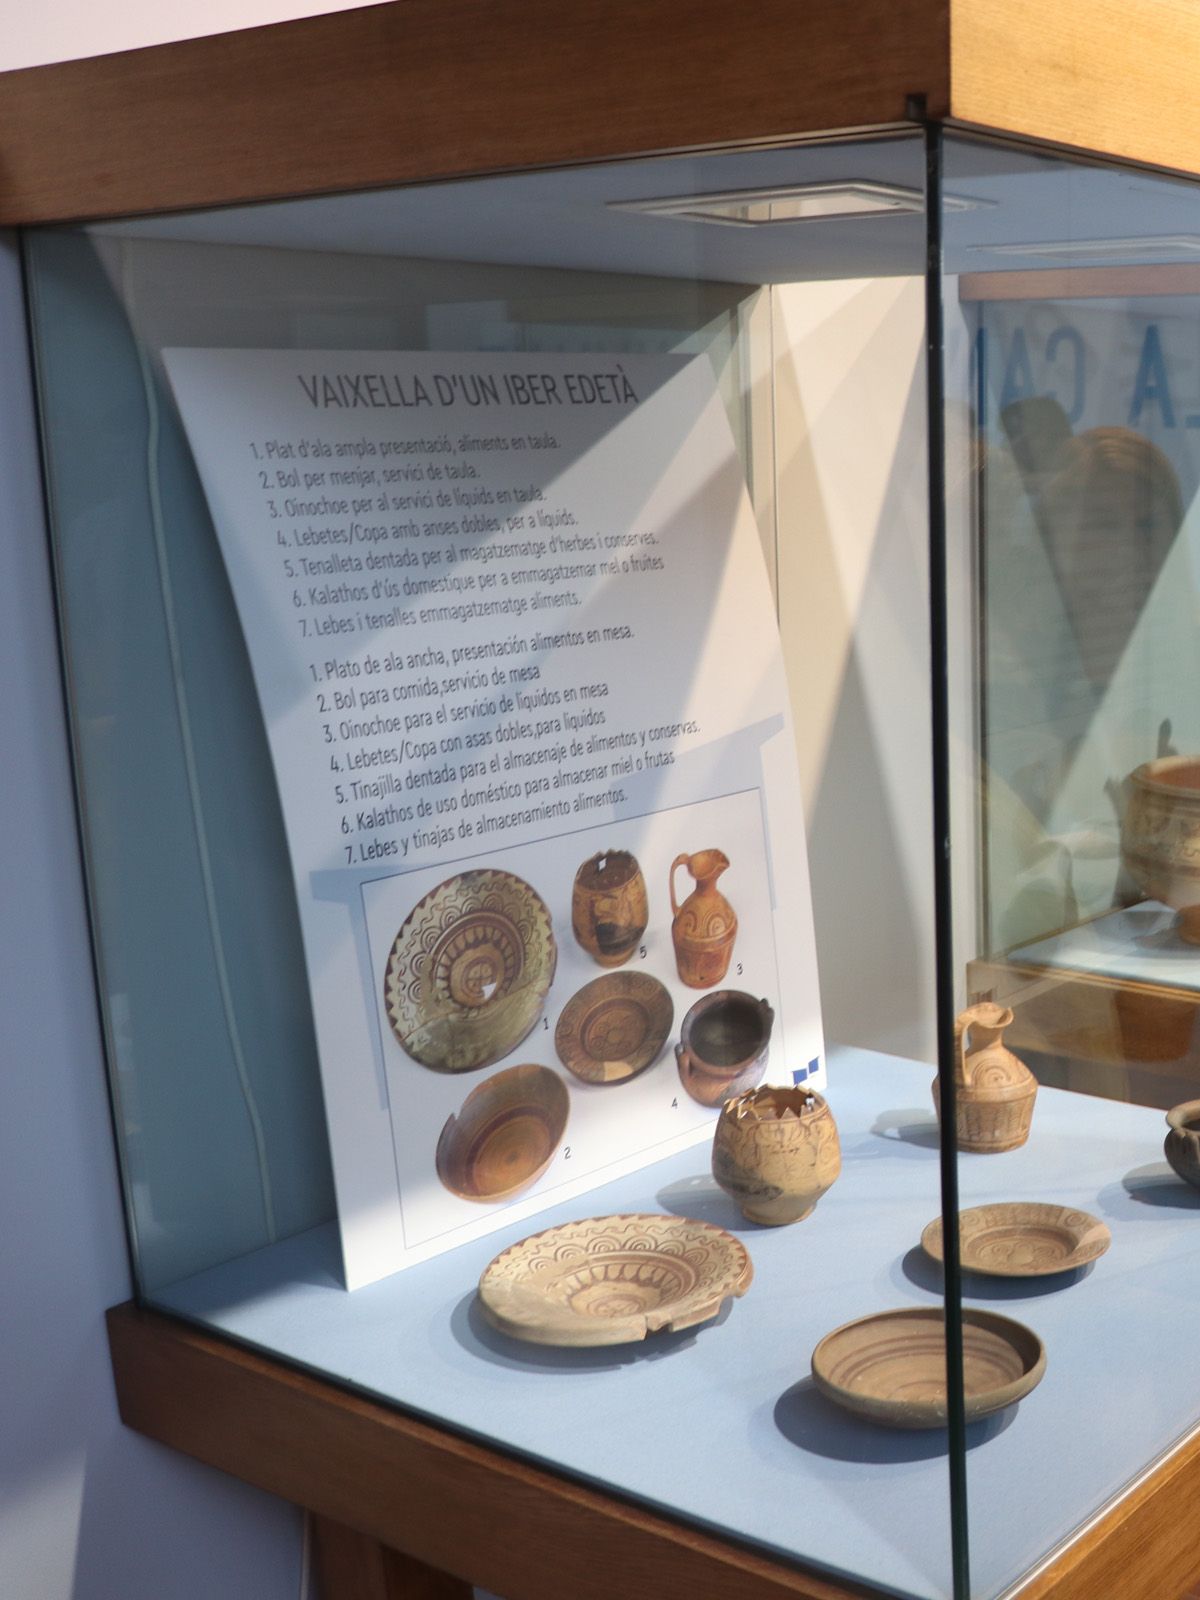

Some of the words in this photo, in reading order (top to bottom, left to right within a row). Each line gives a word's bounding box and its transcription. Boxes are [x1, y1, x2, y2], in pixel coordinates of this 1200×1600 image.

[298, 374, 432, 408] VAIXELLA
[433, 373, 501, 407] D'UN
[503, 373, 562, 406] IBER
[564, 363, 640, 404] EDETÀ
[250, 442, 264, 460] 1.
[266, 440, 296, 459] Plat
[298, 438, 332, 458] d'ala
[336, 438, 376, 459] ampla
[379, 434, 456, 458] presentació,
[458, 434, 509, 453] aliments
[511, 437, 524, 450] en
[528, 433, 561, 450] taula.
[259, 471, 274, 489] 2.
[277, 469, 299, 488] Bol
[304, 471, 325, 490] per
[330, 467, 381, 488] menjar,
[383, 464, 424, 482] servici
[427, 463, 442, 480] de
[445, 461, 480, 479] taula.
[267, 500, 282, 518] 3.
[284, 495, 348, 517] Oinochoe
[352, 497, 373, 515] per
[378, 493, 389, 511] al
[392, 490, 433, 510] servici
[436, 489, 451, 508] de
[497, 491, 512, 504] en
[513, 484, 547, 501] taula.
[277, 530, 292, 548] 4.
[392, 519, 420, 539] amb
[423, 521, 459, 537] anses
[461, 515, 505, 534] dobles,
[506, 516, 526, 534] per
[284, 560, 299, 578] 5.
[299, 555, 362, 577] Tenalleta
[366, 549, 419, 571] dentada
[422, 550, 442, 569] per
[446, 544, 458, 562] al
[460, 541, 547, 563] magatzematge
[549, 534, 596, 554] d'herbes
[604, 531, 660, 549] conserves.
[292, 590, 306, 608] 6.
[308, 583, 368, 606] Kalathos
[371, 579, 400, 599] d'ús
[402, 573, 475, 595] domestique
[477, 573, 497, 592] per
[511, 563, 597, 585] emmagatzemar
[600, 556, 619, 574] mel
[629, 553, 665, 571] fruites
[299, 619, 312, 638] 7.
[314, 614, 355, 636] Lebes
[364, 606, 416, 631] tenalles
[419, 598, 529, 623] emmagatzematge
[530, 591, 582, 610] aliments.
[309, 663, 323, 682] 1.
[325, 658, 360, 680] Plato
[364, 655, 381, 675] de
[383, 651, 403, 672] ala
[407, 646, 449, 668] ancha,
[452, 634, 528, 666] presentación
[531, 631, 585, 651] alimentos
[587, 629, 601, 644] en
[602, 624, 634, 641] mesa.
[316, 694, 331, 713] 2.
[333, 688, 356, 711] Bol
[360, 688, 389, 711] para
[491, 665, 506, 685] de
[509, 664, 540, 684] mesa
[323, 724, 337, 744] 3.
[339, 713, 401, 741] Oinochoe
[404, 711, 433, 733] para
[436, 704, 447, 723] el
[450, 697, 497, 722] servicio
[499, 693, 514, 713] de
[563, 686, 578, 702] en
[580, 681, 609, 700] mesa
[330, 754, 344, 772] 4.
[440, 735, 462, 753] con
[465, 731, 492, 749] asas
[335, 785, 348, 804] 5.
[350, 773, 401, 801] Tinajilla
[405, 763, 457, 789] dentada
[460, 762, 487, 783] para
[490, 751, 500, 773] el
[503, 742, 567, 770] almacenaje
[569, 737, 584, 757] de
[586, 730, 637, 753] alimentos
[648, 718, 701, 742] conservas.
[341, 816, 353, 835] 6.
[356, 804, 414, 832] Kalathos
[416, 798, 433, 818] de
[436, 797, 458, 814] uso
[460, 781, 522, 808] doméstico
[524, 777, 549, 799] para
[552, 764, 608, 791] almacenar
[611, 755, 634, 776] miel
[644, 750, 675, 770] frutas
[344, 846, 357, 865] 7.
[359, 838, 398, 862] Lebes
[413, 825, 455, 850] tinajas
[458, 819, 473, 840] de
[476, 799, 571, 835] almacenamiento
[573, 786, 628, 813] alimentos.
[638, 945, 648, 960] 5
[735, 962, 744, 977] 3
[542, 1017, 549, 1032] 1
[671, 1097, 679, 1111] 4
[563, 1147, 572, 1160] 2
